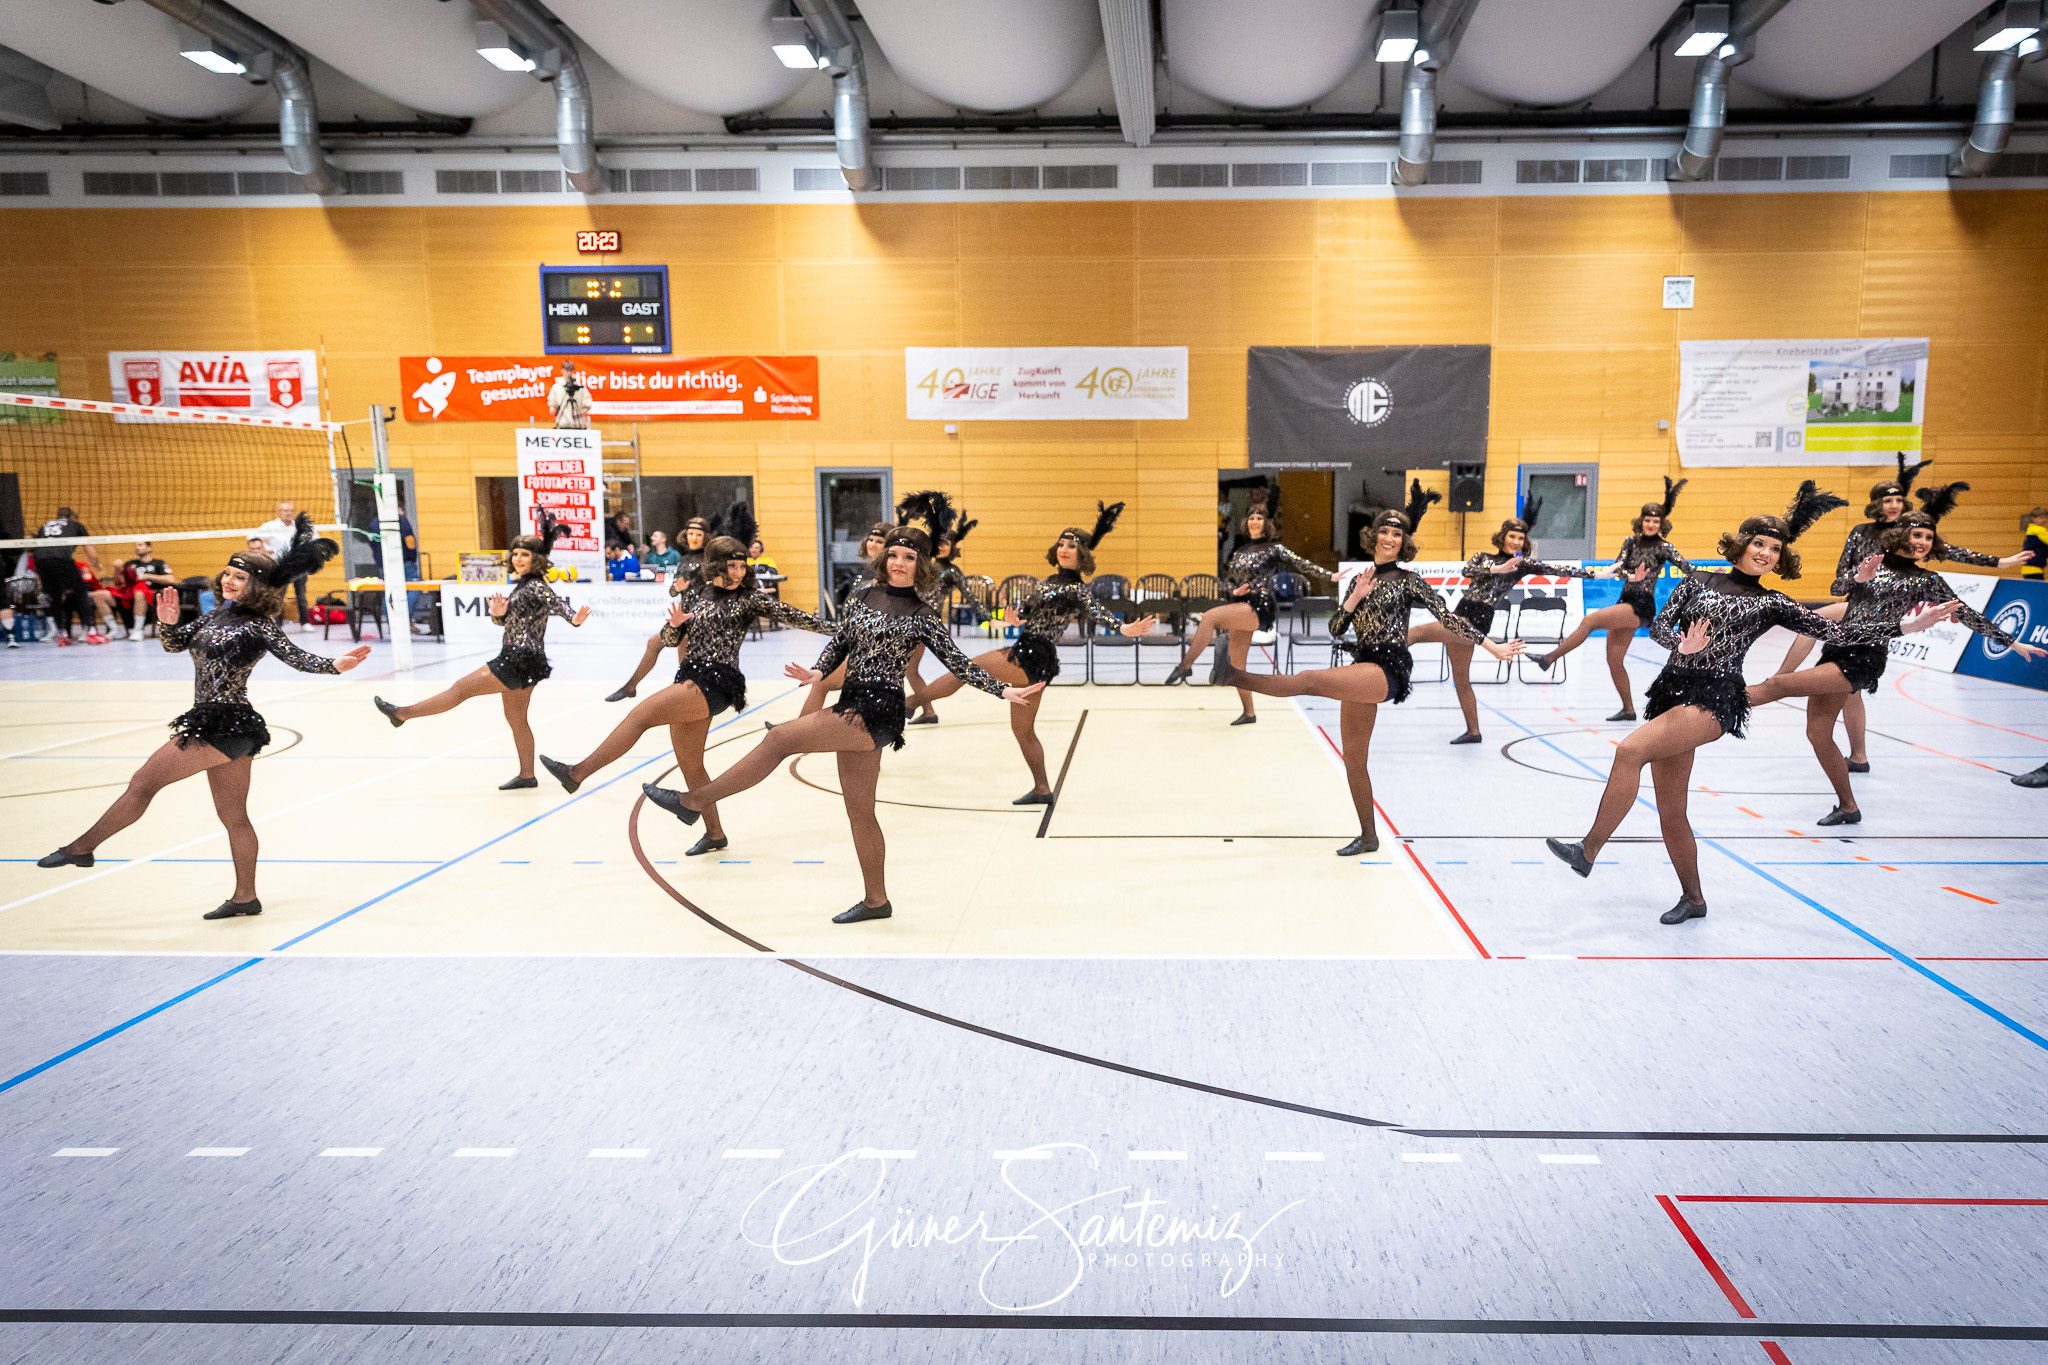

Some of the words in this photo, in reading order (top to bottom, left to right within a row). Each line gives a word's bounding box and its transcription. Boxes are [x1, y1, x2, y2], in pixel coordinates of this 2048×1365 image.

[548, 303, 588, 315] HEIM
[621, 303, 660, 315] GAST
[1776, 347, 1841, 357] Knebelstraße
[466, 364, 553, 385] Teamplayer
[969, 367, 1003, 377] JAHRE
[1018, 366, 1061, 377] ZugKunft
[1136, 368, 1177, 382] JAHRE
[610, 370, 646, 389] bist
[649, 370, 673, 389] du
[677, 370, 743, 393] richtig.
[1013, 379, 1046, 387] kommt
[480, 382, 546, 406] gesucht!
[971, 383, 1000, 399] IGE
[1018, 391, 1061, 399] Herkunft
[770, 393, 813, 404] Sparkasse
[771, 404, 811, 416] Nürnberg
[525, 436, 593, 449] MEYSEL
[536, 461, 583, 475] SCHILDER
[526, 476, 592, 490] FOTOTAPETEN
[536, 492, 587, 506] SCHRIFTEN
[1900, 642, 1917, 657] 57
[1915, 645, 1930, 661] 71
